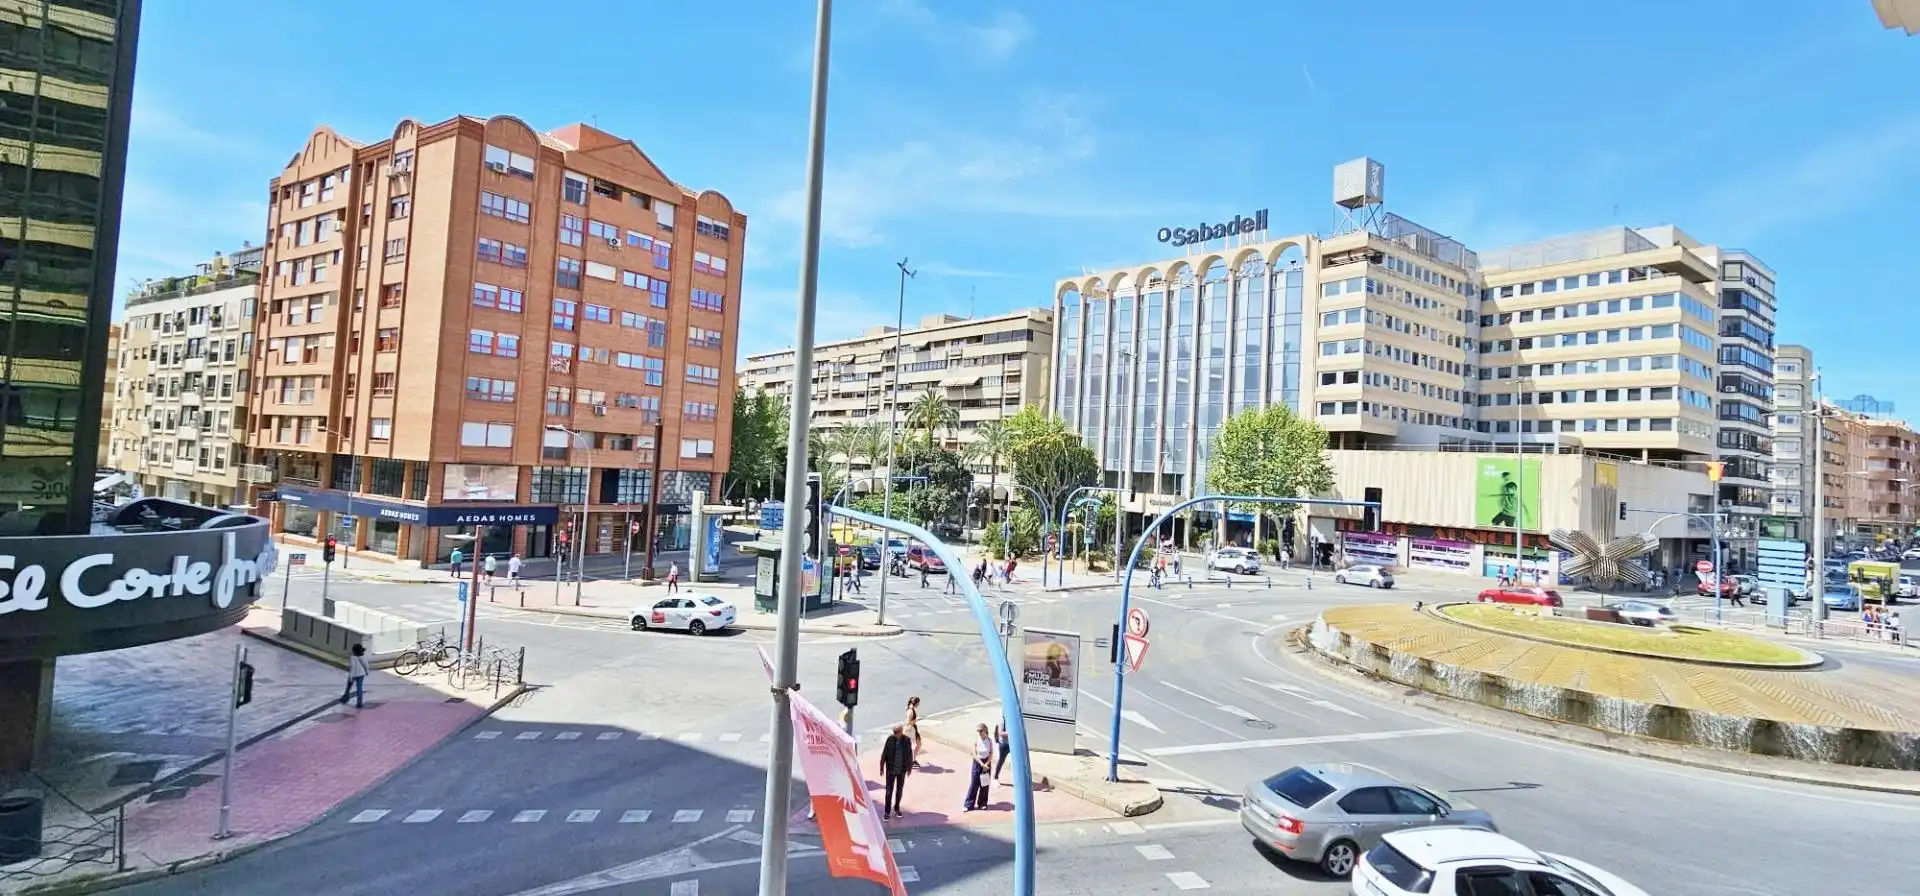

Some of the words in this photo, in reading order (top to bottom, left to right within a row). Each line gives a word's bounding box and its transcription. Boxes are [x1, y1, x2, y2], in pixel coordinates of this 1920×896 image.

[1171, 208, 1269, 247] Sabadell
[456, 515, 495, 523] AEDAS
[499, 514, 536, 522] HOMES
[60, 553, 210, 609] Corte
